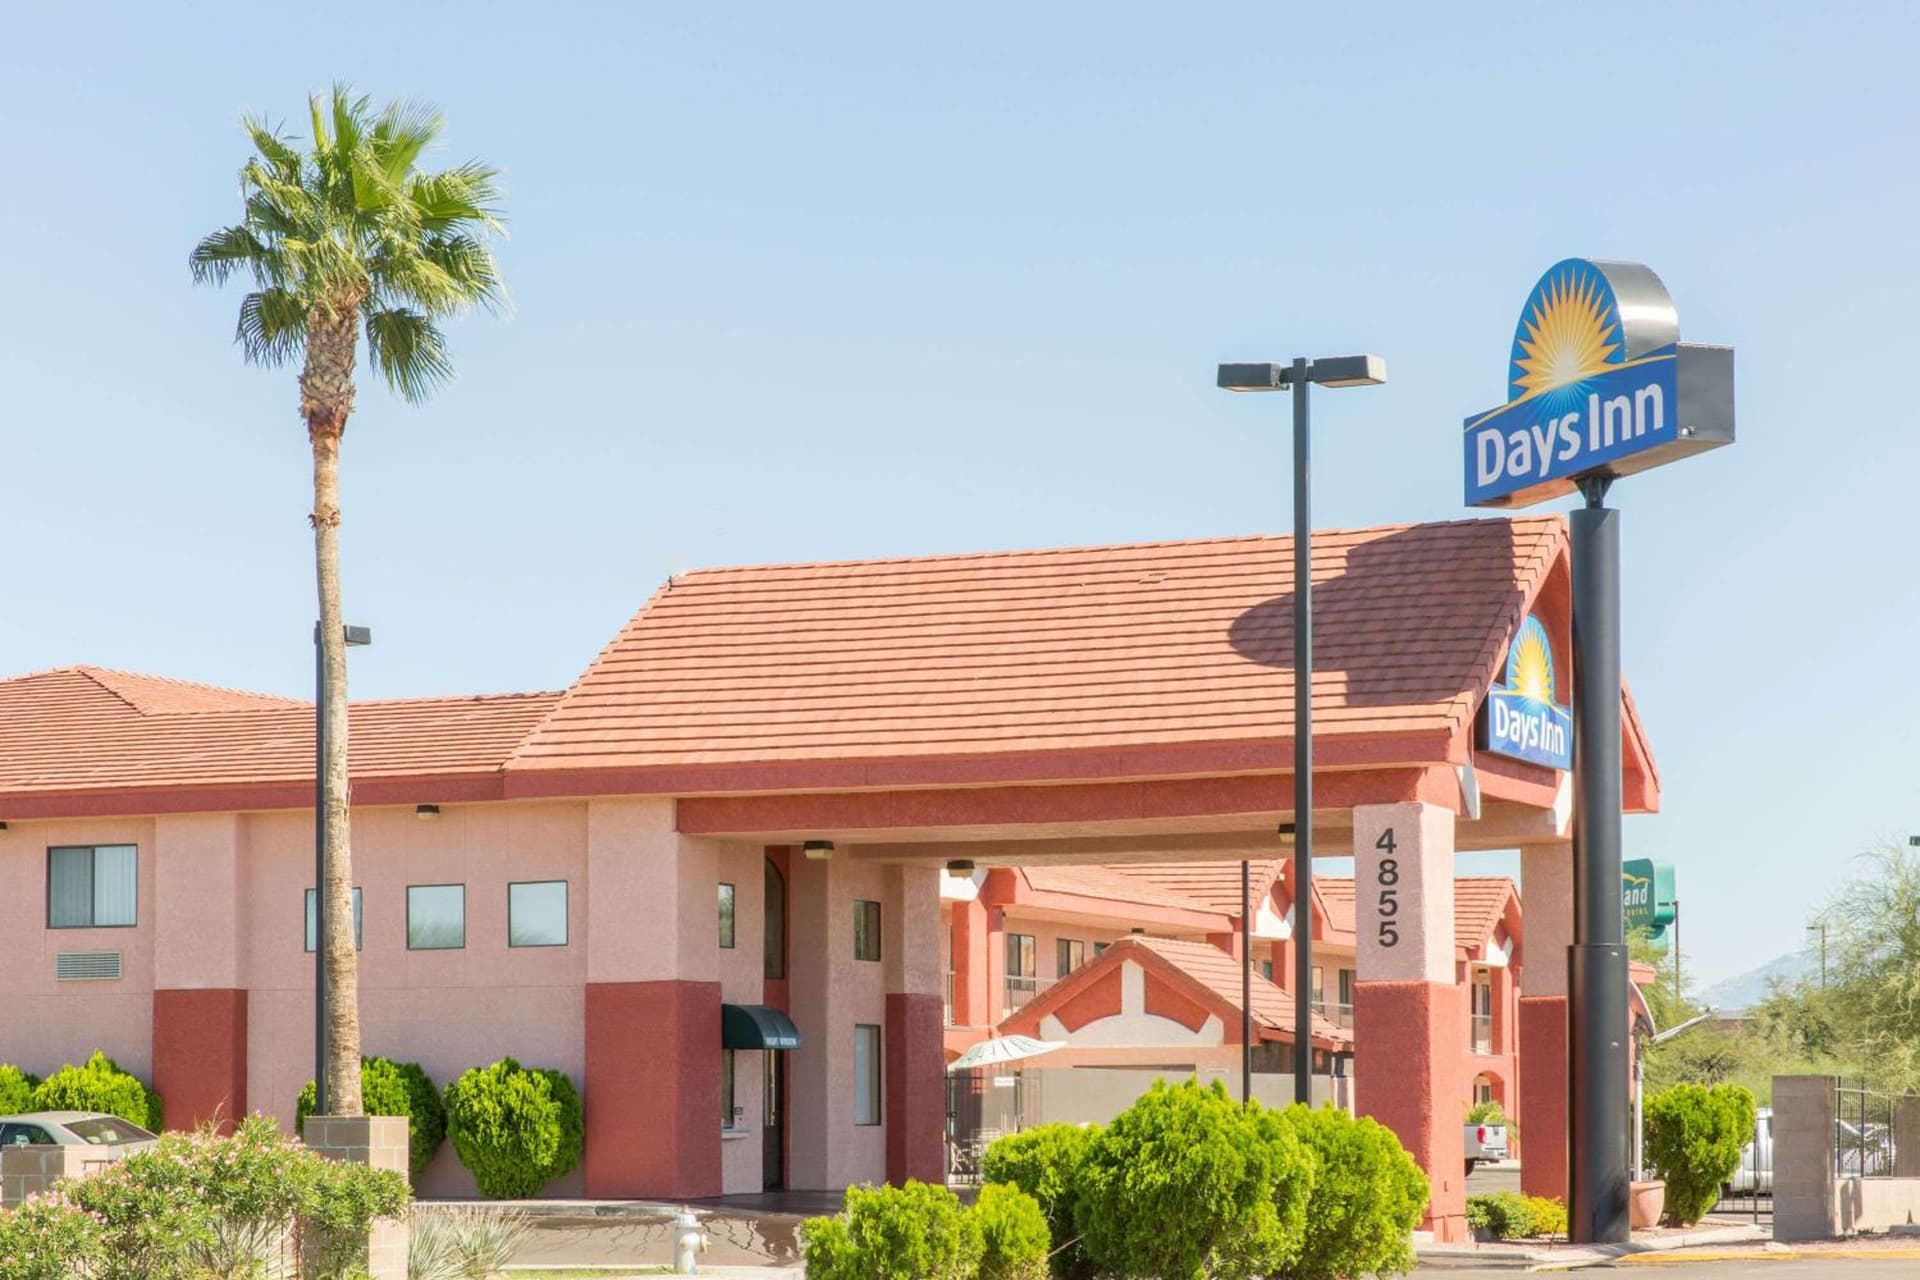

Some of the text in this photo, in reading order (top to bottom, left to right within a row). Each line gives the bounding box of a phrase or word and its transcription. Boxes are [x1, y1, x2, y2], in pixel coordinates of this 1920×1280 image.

[1476, 383, 1664, 487] Days Inn
[1494, 698, 1564, 756] Days Inn
[1375, 827, 1399, 948] 4855
[1623, 881, 1649, 906] and
